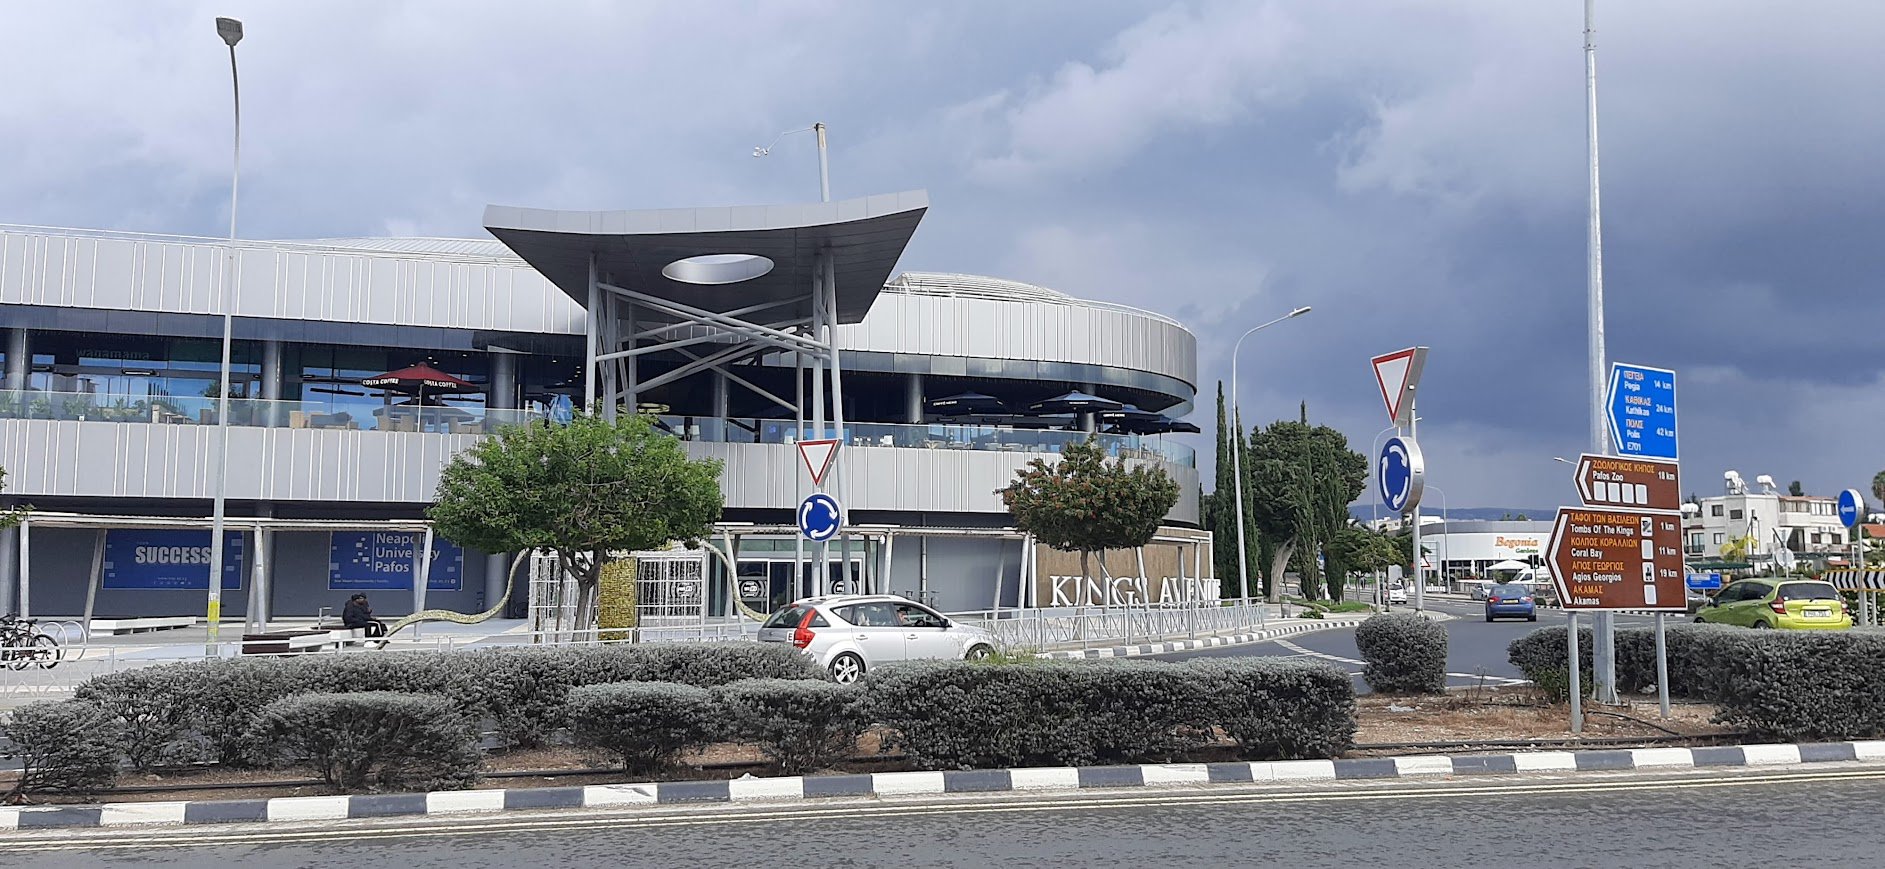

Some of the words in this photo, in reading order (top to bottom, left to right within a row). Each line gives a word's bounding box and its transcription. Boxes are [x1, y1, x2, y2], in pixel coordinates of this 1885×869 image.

[1624, 380, 1640, 392] Pegia
[1654, 380, 1661, 388] 14
[1662, 381, 1672, 390] km
[1626, 406, 1650, 416] Kathikas
[1656, 404, 1663, 412] 24
[1664, 405, 1673, 414] km
[1627, 429, 1640, 438] Polis
[1656, 427, 1664, 436] 42
[1665, 428, 1674, 437] km
[1627, 441, 1642, 451] E701
[1634, 464, 1655, 474] ΚΗΠΟΣ
[1593, 470, 1610, 480] Pafos
[1612, 472, 1624, 481] Zoo
[1658, 471, 1665, 480] 18
[1666, 472, 1675, 480] km
[1570, 513, 1590, 522] ΤΑΦΟΙ
[1593, 514, 1606, 522] ΤΩΝ
[1608, 515, 1639, 524] ΒΑΣΙΛΕΩΝ
[1570, 524, 1591, 533] Tombs
[1593, 525, 1601, 534] Of
[1603, 525, 1615, 534] The
[1616, 526, 1634, 536] Kings
[1665, 522, 1675, 530] km
[376, 533, 425, 546] Neapli
[1495, 536, 1538, 548] Begonia
[1571, 537, 1598, 546] ΚΟΛΠΟΣ
[1600, 538, 1638, 547] ΚΟΡΑΛΛΙΩΝ
[135, 546, 212, 564] SUCCESS
[376, 547, 440, 560] Univesy
[1571, 548, 1589, 557] Coral
[1590, 548, 1603, 559] Bay
[1667, 547, 1676, 555] km
[375, 561, 409, 572] Pafos
[1572, 562, 1591, 570] ΑΓΙΟΣ
[1593, 562, 1624, 571] ΓΕΩΡΓΙΟΣ
[1572, 572, 1591, 582] Agios
[1593, 572, 1622, 583] Georgios
[1660, 569, 1667, 577] 19
[1668, 569, 1678, 578] km
[1050, 575, 1148, 606] KINGS
[1574, 585, 1603, 594] ΑΚΑΜΑΣ
[1574, 596, 1599, 605] Akamas
